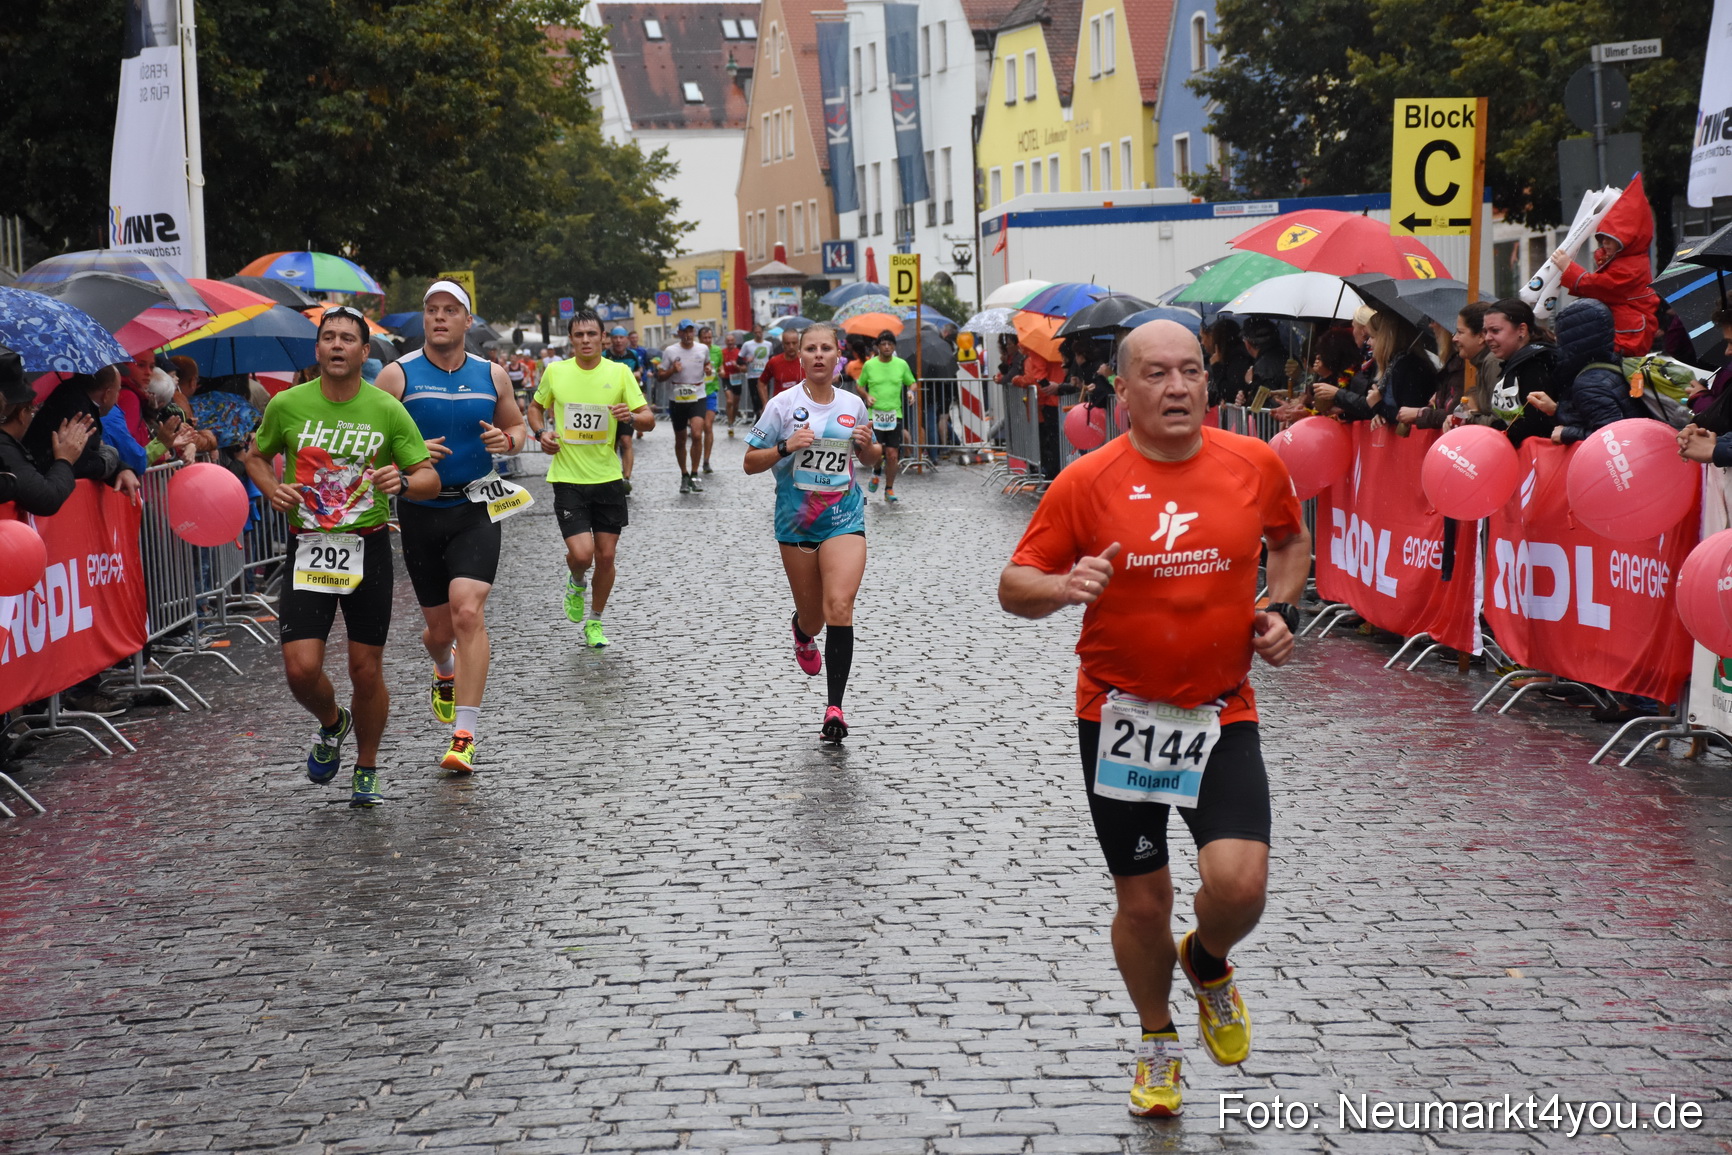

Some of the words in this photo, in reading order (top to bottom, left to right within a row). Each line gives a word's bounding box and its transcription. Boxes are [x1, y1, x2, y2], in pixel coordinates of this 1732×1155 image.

[1604, 46, 1630, 58] Ulmer
[1632, 44, 1658, 55] Gasse
[1404, 104, 1476, 129] Block
[1018, 129, 1040, 153] HOTEL
[1413, 139, 1462, 207] C
[892, 256, 917, 266] Block
[897, 269, 913, 295] D
[356, 422, 371, 430] 2016
[573, 412, 602, 430] 337
[297, 420, 384, 457] HELFER
[800, 449, 847, 473] 2725
[814, 474, 831, 485] Lisa
[1129, 492, 1152, 500] erima
[309, 546, 351, 571] 292
[1126, 547, 1219, 570] funrunners
[1154, 557, 1232, 578] neumarkt
[306, 574, 350, 586] Ferdinand
[1110, 718, 1207, 766] 2144
[1126, 769, 1180, 790] Roland
